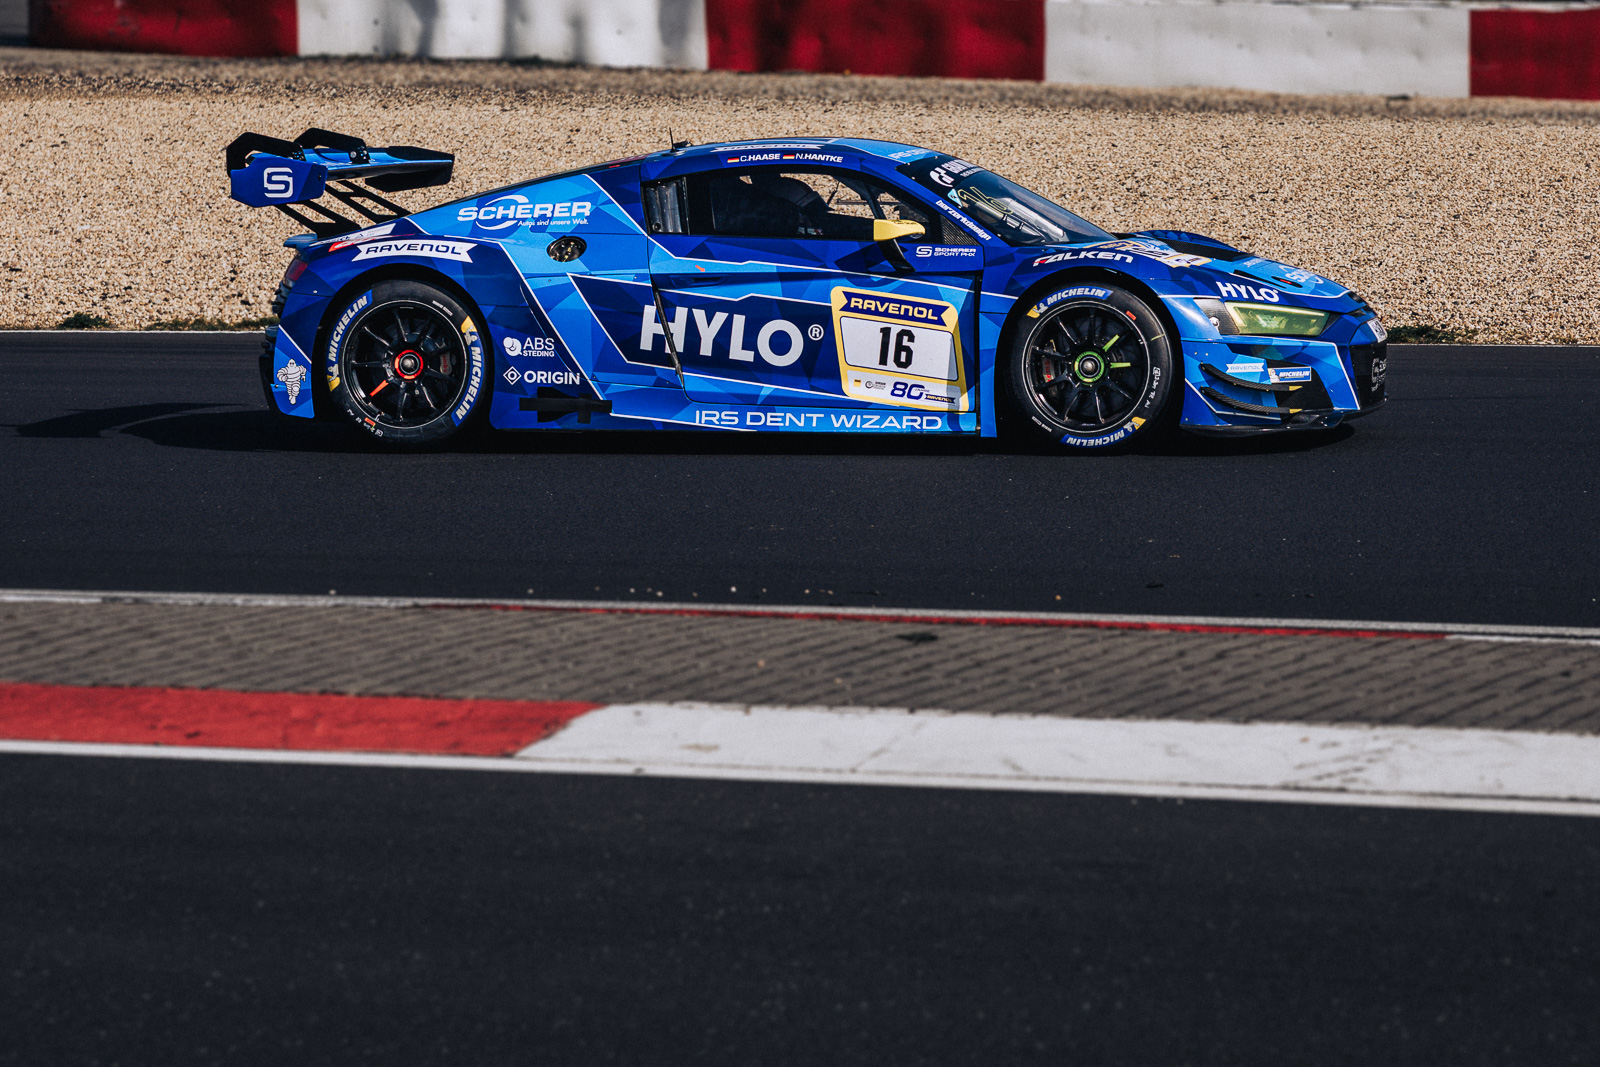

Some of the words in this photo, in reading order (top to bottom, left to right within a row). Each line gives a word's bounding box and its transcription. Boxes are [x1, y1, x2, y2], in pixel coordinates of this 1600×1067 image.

[740, 153, 781, 162] C.HAASE
[795, 153, 844, 163] N.HANTKE
[457, 201, 592, 221] SCHERER
[365, 243, 462, 256] RAVENOL
[1032, 250, 1134, 267] FALKEN
[1047, 287, 1106, 305] MICHELIN
[850, 297, 938, 320] RAVENOL
[328, 295, 368, 362] MICHELIN
[523, 337, 555, 350] ABS
[878, 326, 916, 369] 16
[455, 346, 482, 420] MICHELIN
[524, 370, 580, 385] ORIGIN
[1279, 370, 1310, 378] MICHELIN
[695, 410, 739, 425] IRS
[746, 411, 824, 427] DENT
[831, 413, 942, 430] WIZARD
[1066, 429, 1125, 447] MICHELIN
